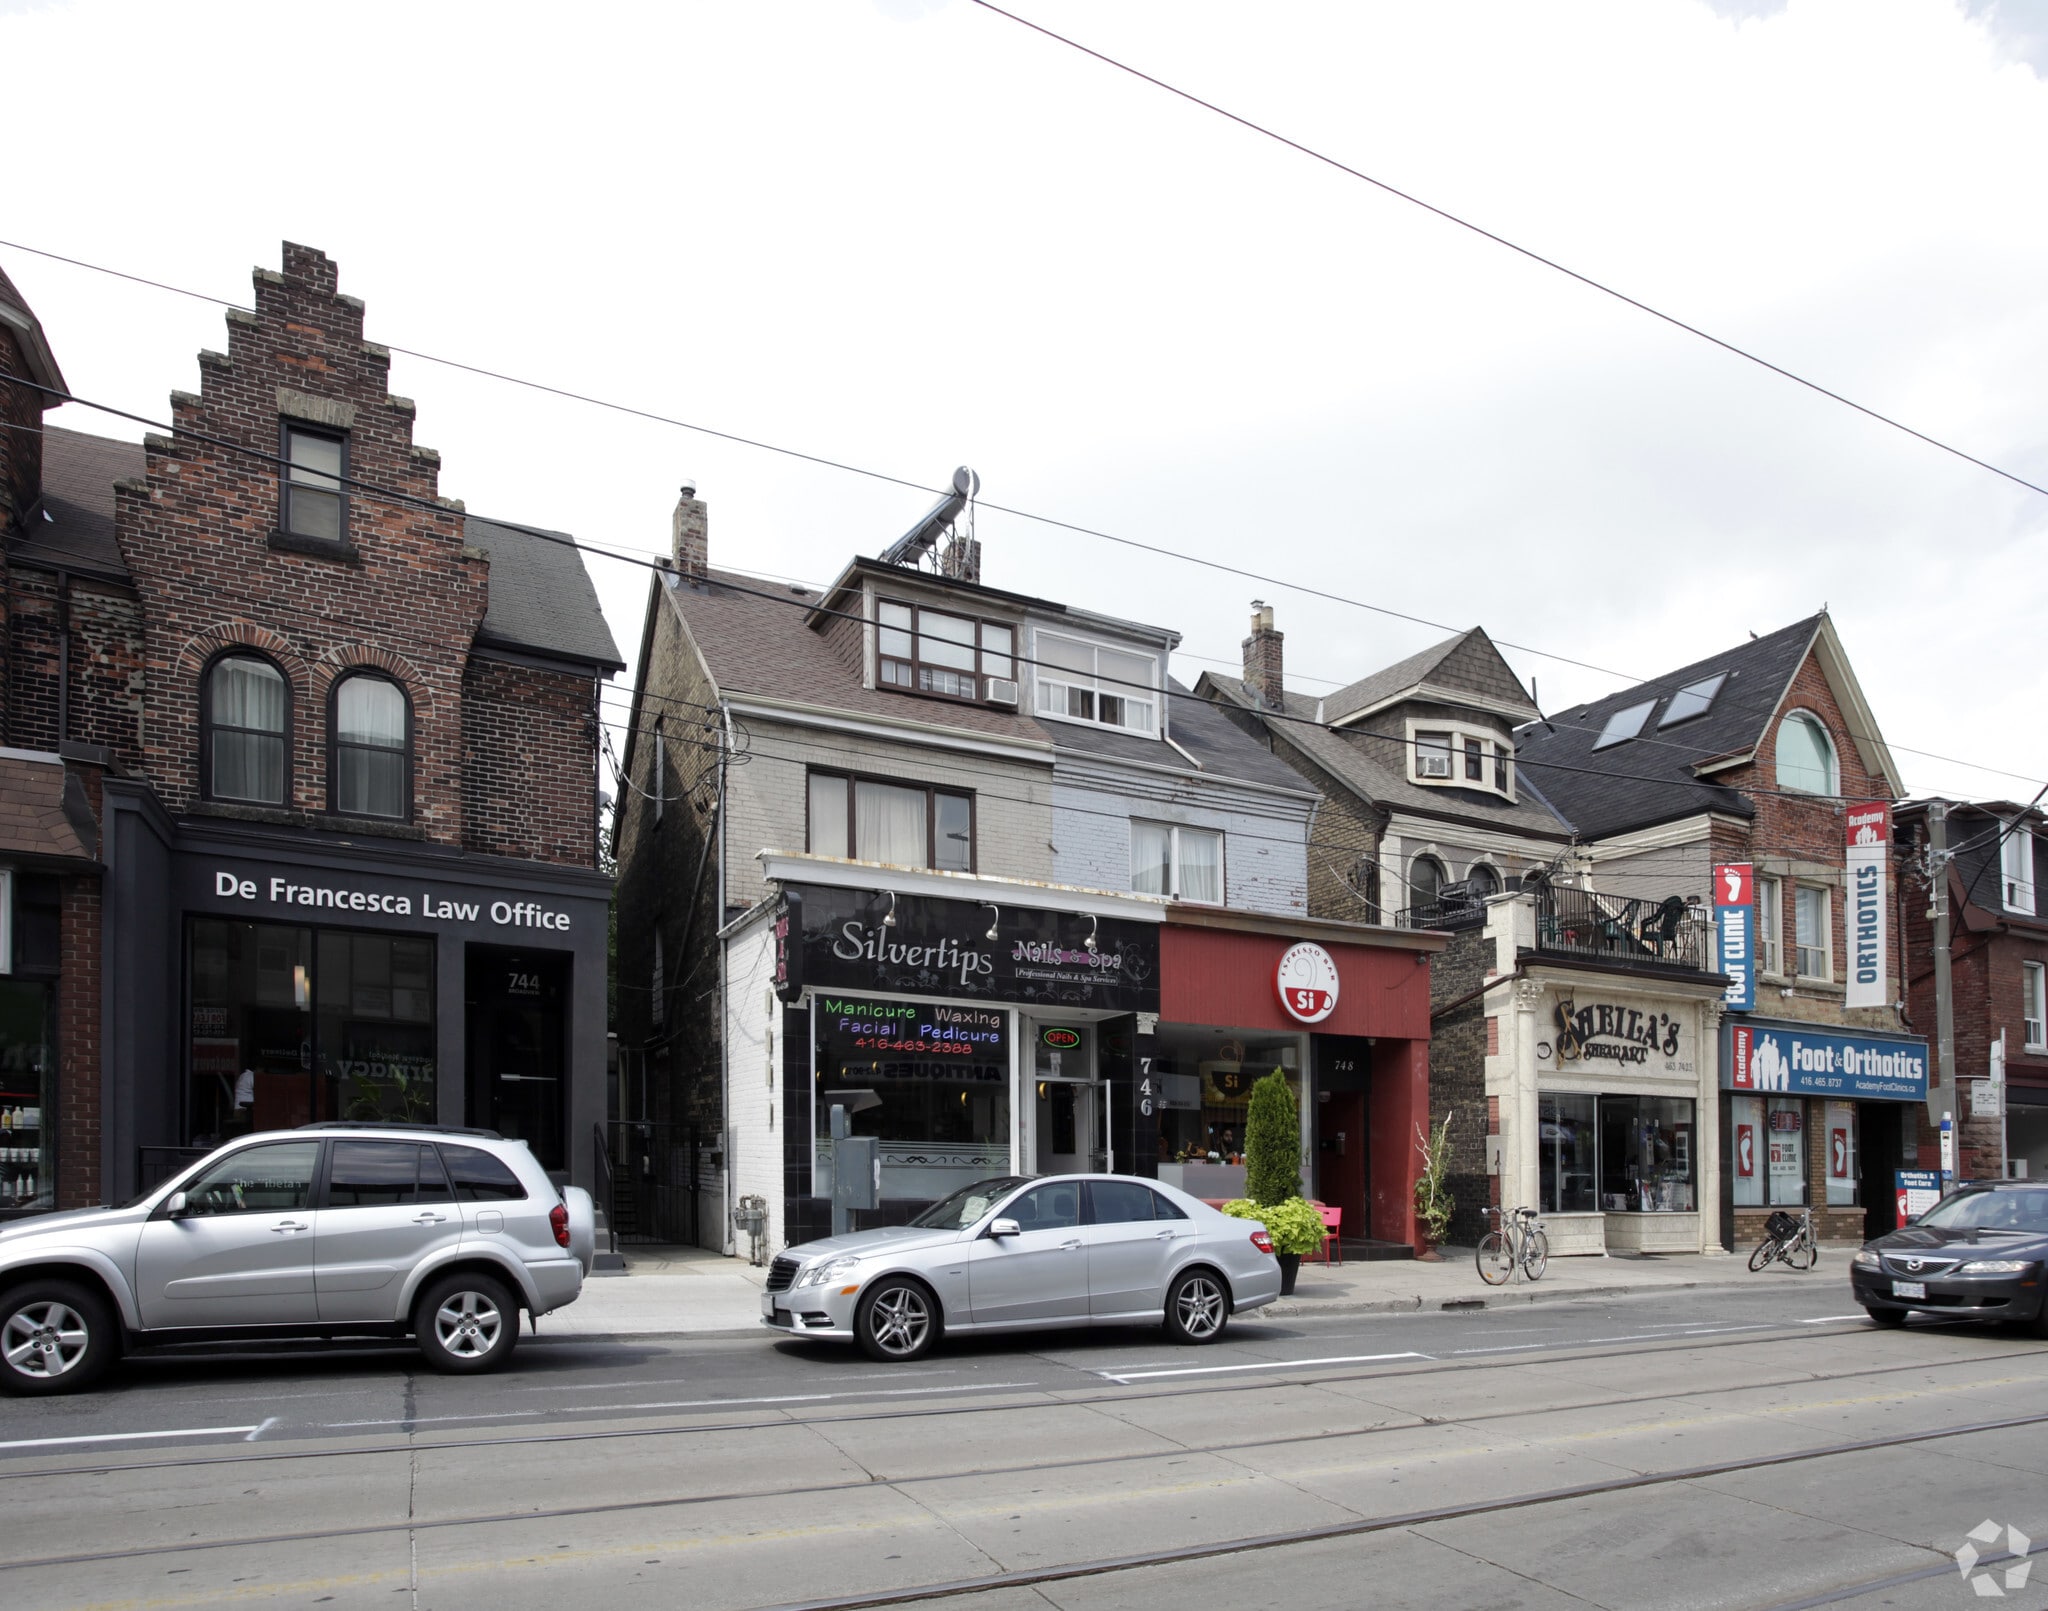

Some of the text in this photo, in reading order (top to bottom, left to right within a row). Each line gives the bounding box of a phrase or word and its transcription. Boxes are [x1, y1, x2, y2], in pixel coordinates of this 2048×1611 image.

[1848, 810, 1884, 828] Academy
[215, 871, 571, 931] De Francesca Law Office
[1856, 865, 1878, 984] ORTHOTICS
[832, 921, 993, 986] Silvertips
[1012, 940, 1122, 974] Nails & Spa
[1723, 909, 1746, 1004] FOOT CLINIC
[1281, 946, 1336, 981] ESPRESSO BAR
[508, 972, 540, 990] 744
[1018, 968, 1056, 980] Professional
[1056, 972, 1072, 981] Nails
[1080, 974, 1092, 984] Spa
[825, 1000, 916, 1019] Manicure
[1296, 990, 1315, 1010] Si
[839, 1018, 1000, 1043] Facial Pedicure
[1047, 1033, 1075, 1043] OPEN
[1554, 1000, 1681, 1060] SHEILA'S
[855, 1037, 973, 1055] 416-463-2388
[1335, 1060, 1354, 1071] 748
[1736, 1030, 1748, 1083] Academy
[1140, 1057, 1152, 1116] 746
[1224, 1074, 1239, 1088] Si
[1855, 1080, 1916, 1093] AcademyFootClinics.ca
[1900, 1171, 1928, 1180] Orthotics
[1904, 1179, 1918, 1187] Foot
